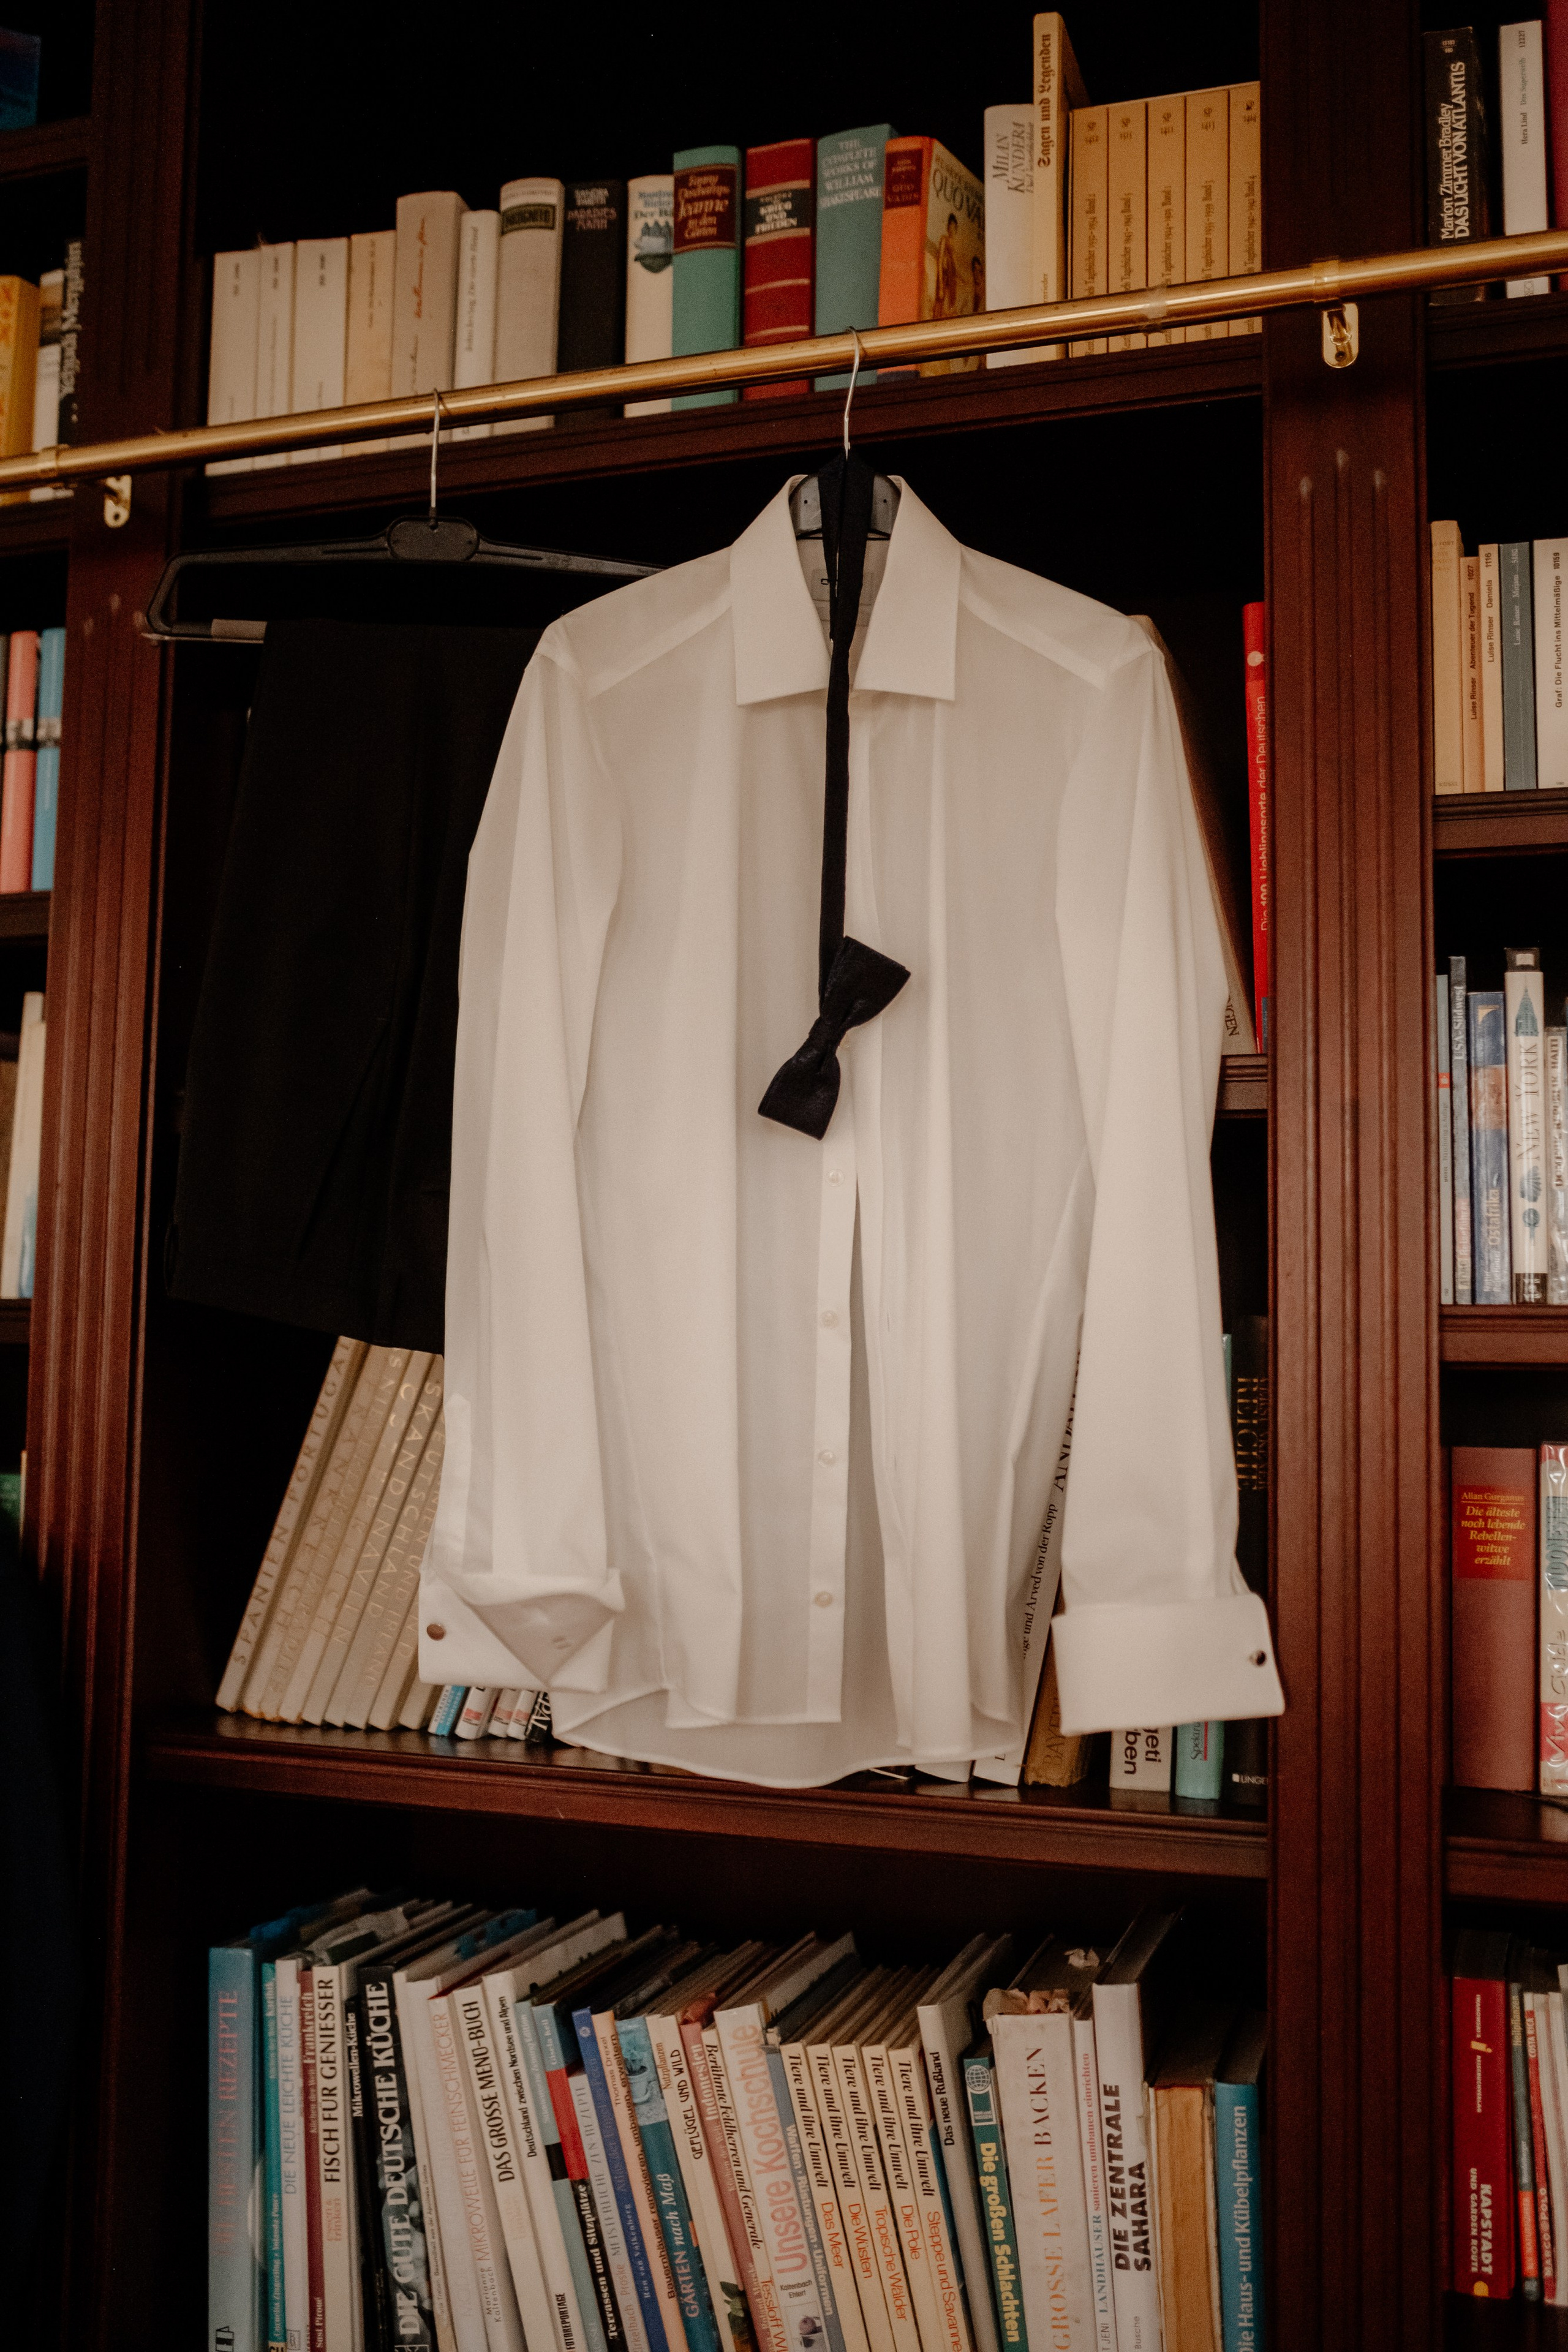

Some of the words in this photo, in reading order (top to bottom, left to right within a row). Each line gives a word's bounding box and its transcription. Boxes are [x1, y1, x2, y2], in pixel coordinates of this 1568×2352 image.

[1037, 34, 1055, 95] Legenden
[1038, 97, 1051, 121] und
[1450, 61, 1467, 130] ATLANTIS
[1037, 126, 1055, 168] Sagen
[1439, 103, 1454, 148] Bradley
[1452, 130, 1468, 165] VON
[825, 173, 874, 191] WILLIAM
[991, 132, 1010, 184] MILAN
[1007, 121, 1026, 194] KUNDERA
[1439, 148, 1453, 195] Zimmer
[818, 186, 882, 209] SHAKESPEARE
[1453, 165, 1469, 206] LICHT
[1441, 197, 1455, 240] Marion
[1454, 206, 1469, 239] DAS
[1468, 592, 1477, 619] Tugend
[1512, 605, 1521, 626] Rinser
[1553, 575, 1562, 628] Mittelmäßige
[1255, 696, 1266, 764] Deutschen
[1453, 986, 1467, 1060] USA-Südwest
[1513, 1043, 1539, 1100] YORK
[1514, 1110, 1540, 1161] NEW
[1486, 1189, 1501, 1246] Ostafrika
[333, 1382, 442, 1645] SKANDINAVIEN
[1041, 1504, 1058, 1534] Ropp
[1461, 1492, 1483, 1501] Allan
[1484, 1493, 1525, 1502] Gurganus
[1466, 1506, 1484, 1517] Die
[1485, 1507, 1521, 1518] älteste
[1036, 1534, 1050, 1553] der
[1461, 1518, 1485, 1529] noch
[1487, 1519, 1526, 1530] lebende
[1469, 1530, 1518, 1541] Rebellen-
[1476, 1543, 1510, 1553] witwe
[1033, 1555, 1046, 1575] von
[1474, 1556, 1512, 1566] erzählt
[232, 1524, 289, 1666] SPANIEN
[1025, 1575, 1041, 1611] Arved
[1023, 1612, 1034, 1635] und
[279, 1995, 294, 2048] KÜCHE
[301, 1992, 316, 2064] Frankreich
[317, 1978, 337, 2080] GENIESSER
[365, 1981, 395, 2068] KÜCHE
[497, 1996, 511, 2018] Alpen
[500, 2018, 513, 2034] und
[345, 2012, 363, 2117] Mikrowellen-Küche
[461, 2000, 497, 2090] MENÜ-BUCH
[505, 2034, 519, 2068] Nordsee
[600, 2037, 612, 2067] Drexel
[655, 2043, 673, 2090] Nutzpflanzen
[669, 2049, 683, 2077] WILD
[281, 2054, 295, 2114] LEICHTE
[433, 2013, 468, 2133] FEINSCHMECKER
[512, 2068, 527, 2105] zwischen
[609, 2069, 622, 2108] Thomas
[677, 2079, 691, 2103] UND
[690, 2043, 720, 2121] Indonesien
[705, 2044, 728, 2103] Berühmte
[929, 2051, 946, 2095] Rußland
[1025, 2046, 1052, 2146] BACKEN
[1082, 2052, 1093, 2108] einrichten
[321, 2086, 339, 2122] FÜR
[480, 2091, 508, 2149] GROSSE
[728, 2024, 788, 2175] Kochschule
[788, 2053, 804, 2085] Tiere
[807, 2141, 829, 2188] Umwelt
[815, 2054, 831, 2086] Tiere
[835, 2143, 856, 2189] Umwelt
[842, 2056, 858, 2088] Tiere
[861, 2144, 883, 2192] Umwelt
[870, 2054, 886, 2087] Tiere
[889, 2144, 909, 2190] Umwelt
[940, 2097, 951, 2124] neue
[282, 2120, 296, 2165] NEUE
[375, 2072, 409, 2206] DEUTSCHE
[455, 2137, 473, 2165] FÜR
[516, 2106, 538, 2158] Deutschland
[682, 2105, 704, 2160] GEFLÜGEL
[718, 2106, 742, 2168] Feldherren
[898, 2060, 914, 2092] Tiere
[915, 2150, 935, 2197] Umwelt
[943, 2125, 956, 2146] Das
[1086, 2111, 1098, 2162] umbauen
[1102, 2084, 1129, 2220] ZENTRALE
[322, 2128, 341, 2183] FISCH
[492, 2150, 515, 2184] DAS
[735, 2169, 748, 2192] und
[979, 2143, 998, 2173] Die
[1232, 2105, 1254, 2234] Kübelpflanzen
[284, 2169, 297, 2195] DIE
[656, 2173, 676, 2206] Maß
[979, 2175, 1008, 2241] großen
[1090, 2165, 1101, 2212] sanieren
[462, 2169, 491, 2261] MIKROWELLE
[576, 2184, 599, 2245] Sitzplätze
[666, 2211, 685, 2246] nach
[740, 2195, 763, 2250] Generale
[765, 2180, 808, 2274] Unsere
[786, 2125, 802, 2169] Waffen
[797, 2174, 820, 2243] Rüstungen
[813, 2248, 834, 2315] Uniformen
[821, 2202, 836, 2230] Das
[847, 2203, 862, 2226] Die
[900, 2204, 916, 2228] Die
[1128, 2161, 1152, 2272] SAHARA
[1480, 2183, 1493, 2275] KAPSTADT
[388, 2214, 415, 2283] GUTE
[591, 2248, 603, 2273] und
[650, 2218, 674, 2299] Bauernhäuser
[827, 2232, 845, 2269] Meer
[853, 2225, 874, 2278] Wüsten
[874, 2206, 899, 2271] Tropische
[888, 2272, 908, 2321] Wälder
[905, 2230, 922, 2260] Pole
[927, 2211, 946, 2262] Steppe
[937, 2263, 954, 2290] und
[1092, 2215, 1109, 2313] LANDHÄUSER
[1112, 2228, 1131, 2271] DIE
[1234, 2236, 1251, 2272] und
[479, 2267, 493, 2315] Marianne
[486, 2266, 502, 2323] Kaltenbach
[598, 2276, 619, 2339] Terrassen
[673, 2250, 700, 2318] GÄRTEN
[760, 2275, 782, 2328] Tessloff
[993, 2244, 1022, 2343] Schlachten
[1044, 2246, 1072, 2351] GROSSE
[1237, 2274, 1254, 2328] Haus-
[396, 2291, 421, 2335] DIE
[554, 2292, 576, 2351] FOTOREPORTAGE
[1133, 2315, 1142, 2350] Busche
